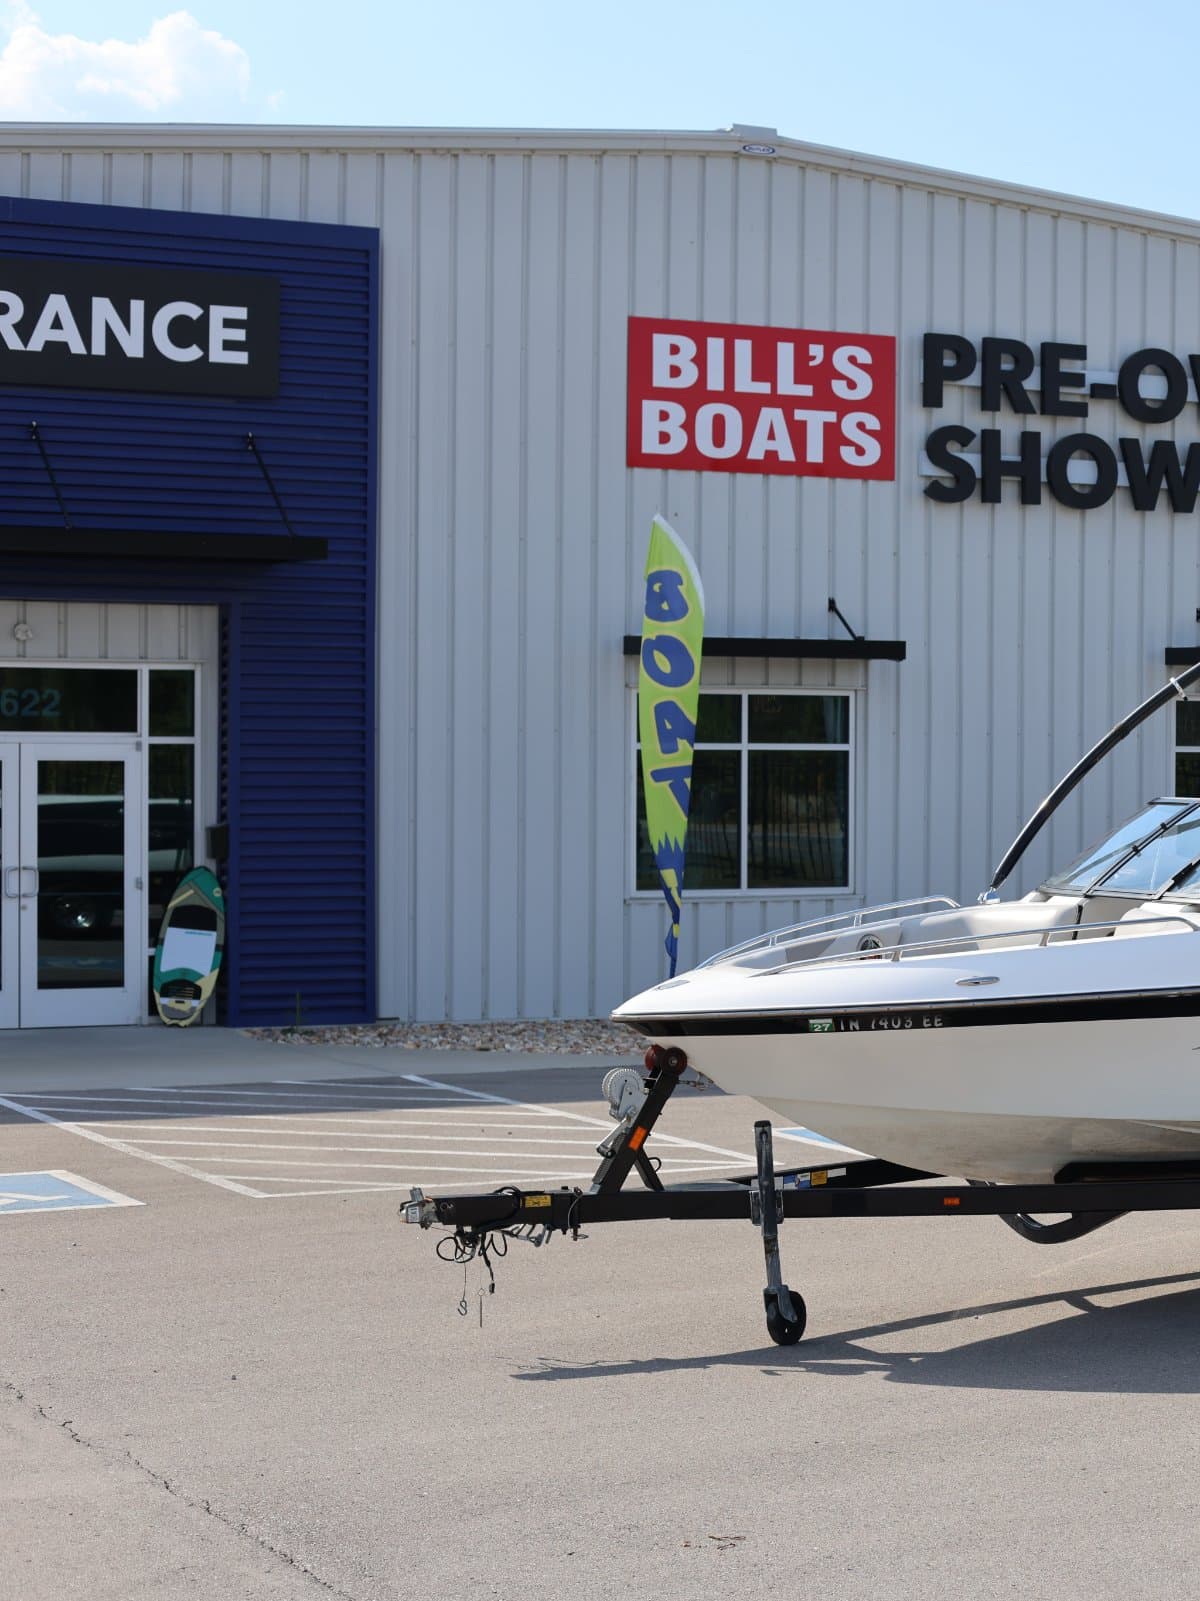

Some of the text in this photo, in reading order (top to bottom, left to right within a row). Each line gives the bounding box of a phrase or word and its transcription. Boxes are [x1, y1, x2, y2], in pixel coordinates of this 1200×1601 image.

[652, 332, 874, 400] BILL'S
[641, 399, 882, 467] BOATS
[0, 687, 63, 718] 622
